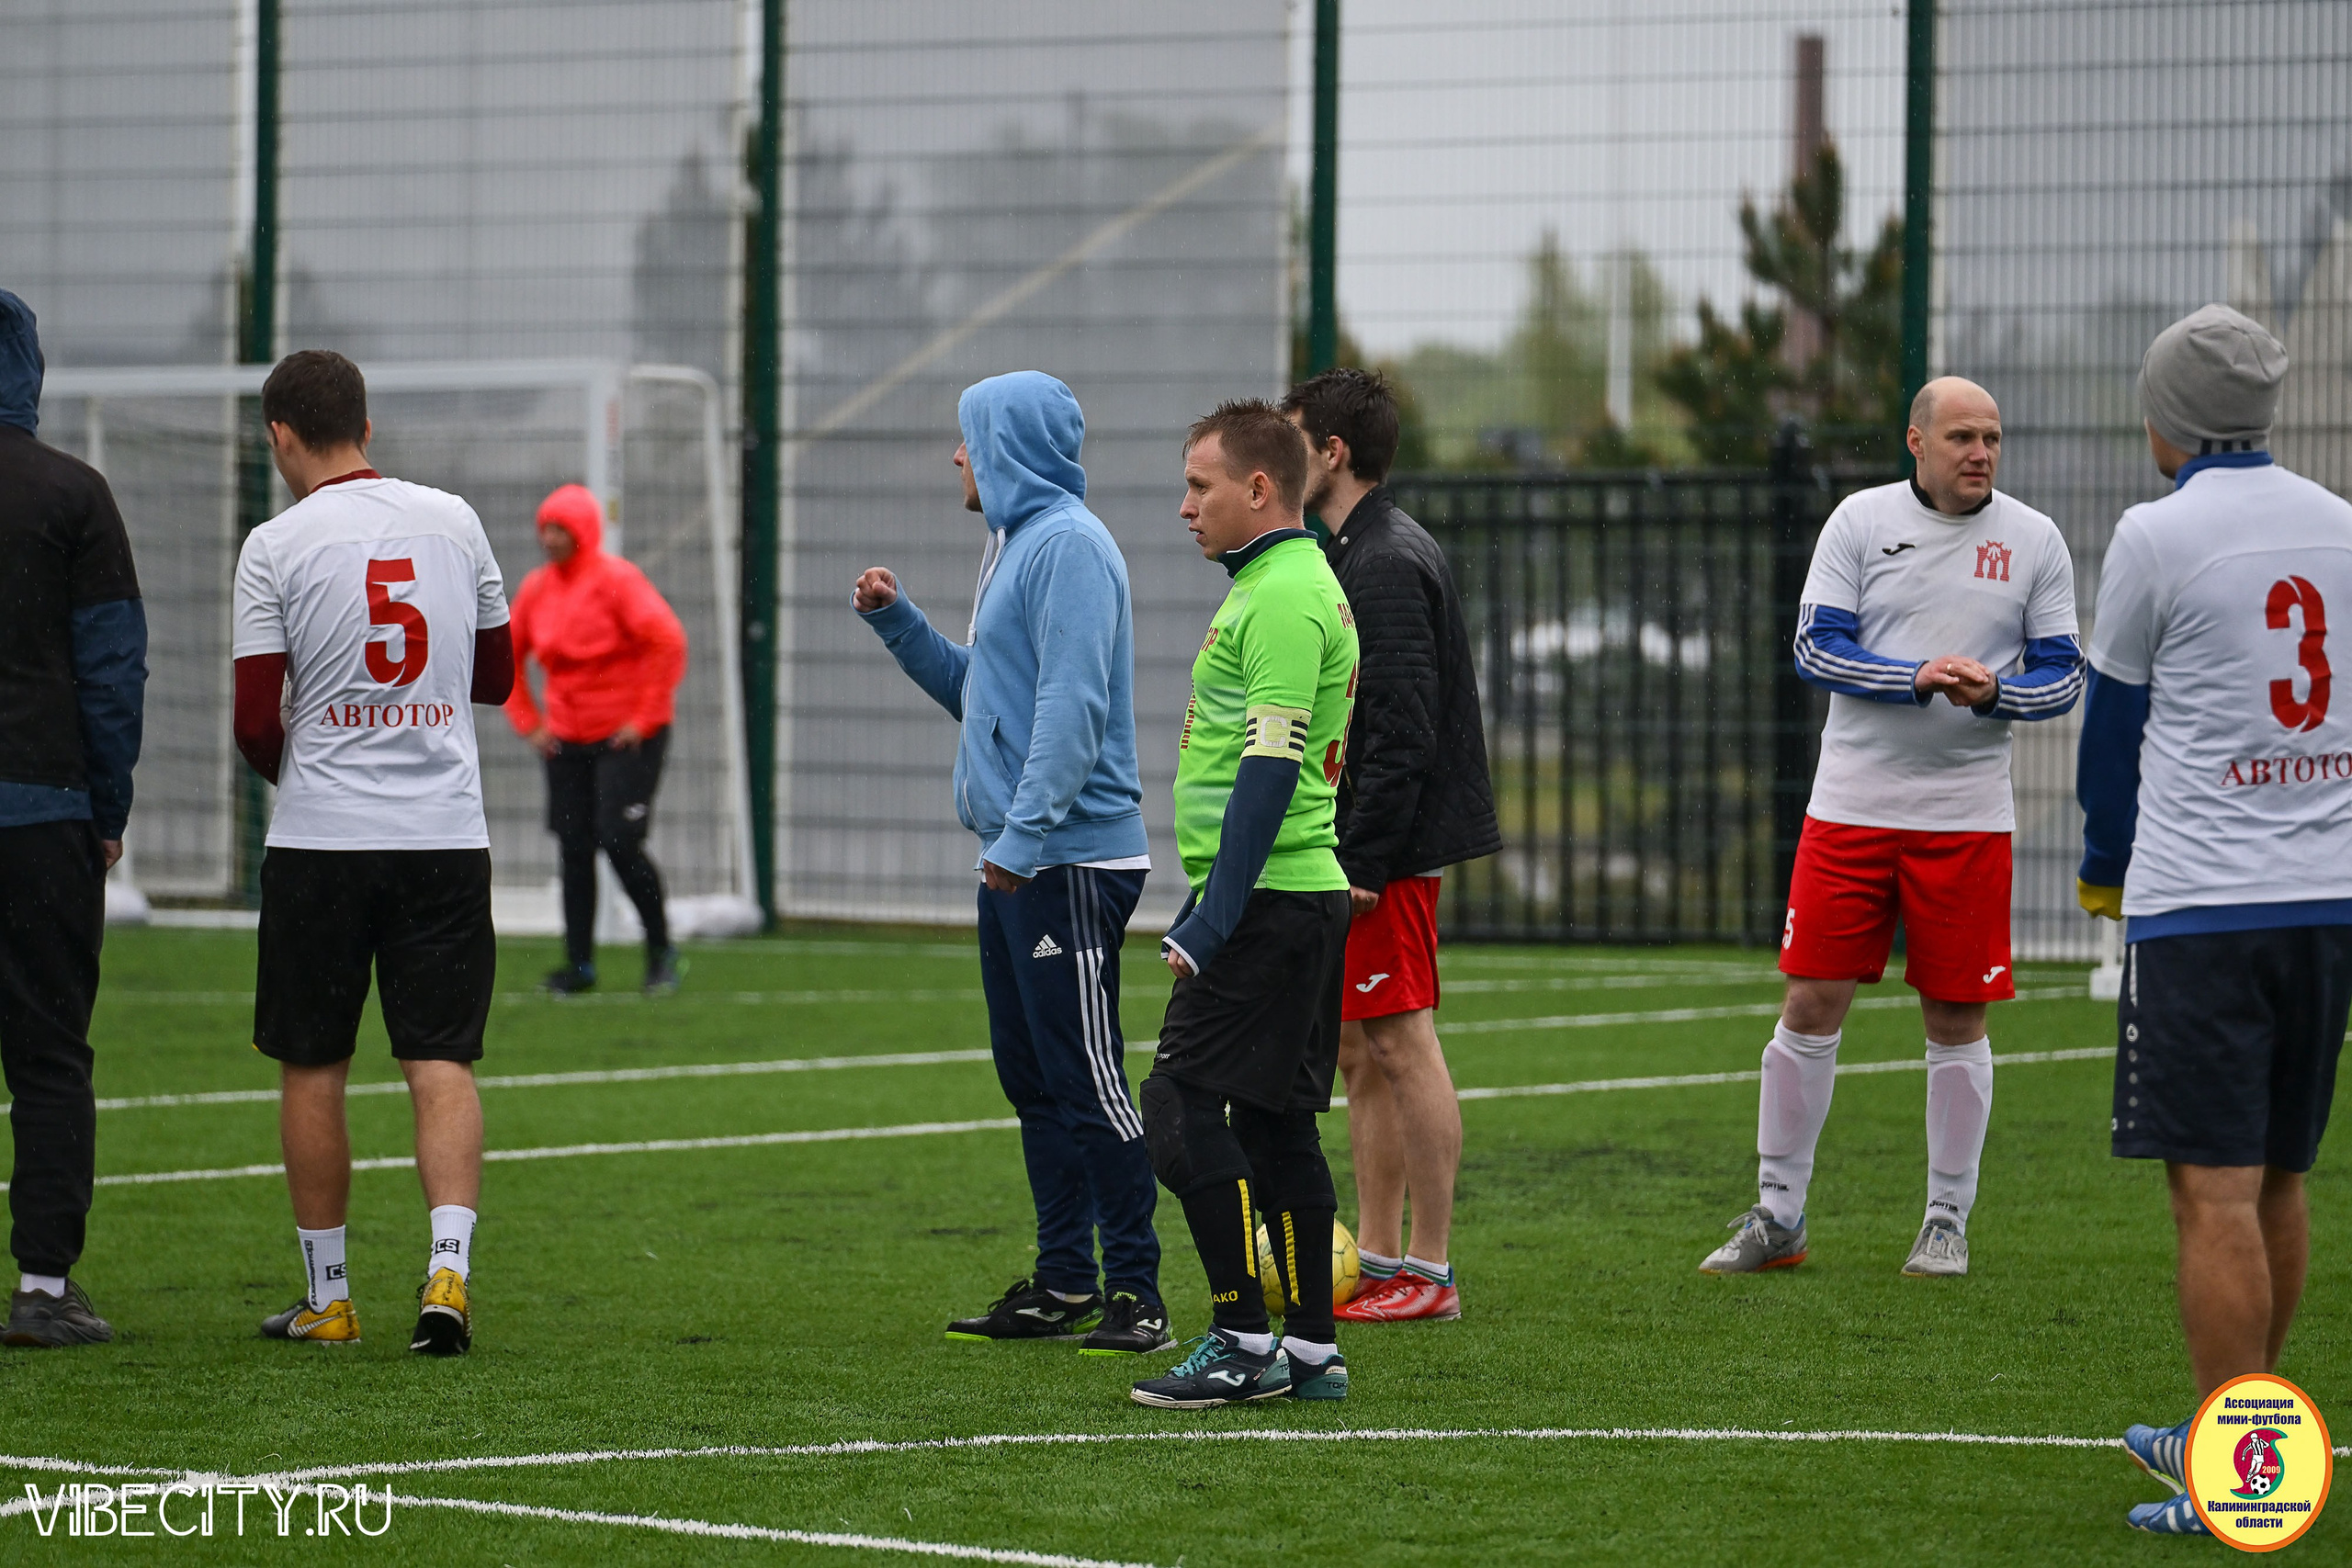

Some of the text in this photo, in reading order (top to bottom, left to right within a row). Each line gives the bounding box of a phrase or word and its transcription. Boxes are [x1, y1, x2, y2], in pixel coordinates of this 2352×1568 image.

[365, 558, 428, 687] 5
[2265, 575, 2332, 733] 3
[320, 704, 454, 728] АВТОТОР
[1261, 716, 1288, 748] C
[1782, 907, 1795, 950] 5
[1033, 947, 1062, 958] adidas
[435, 1239, 458, 1252] CS
